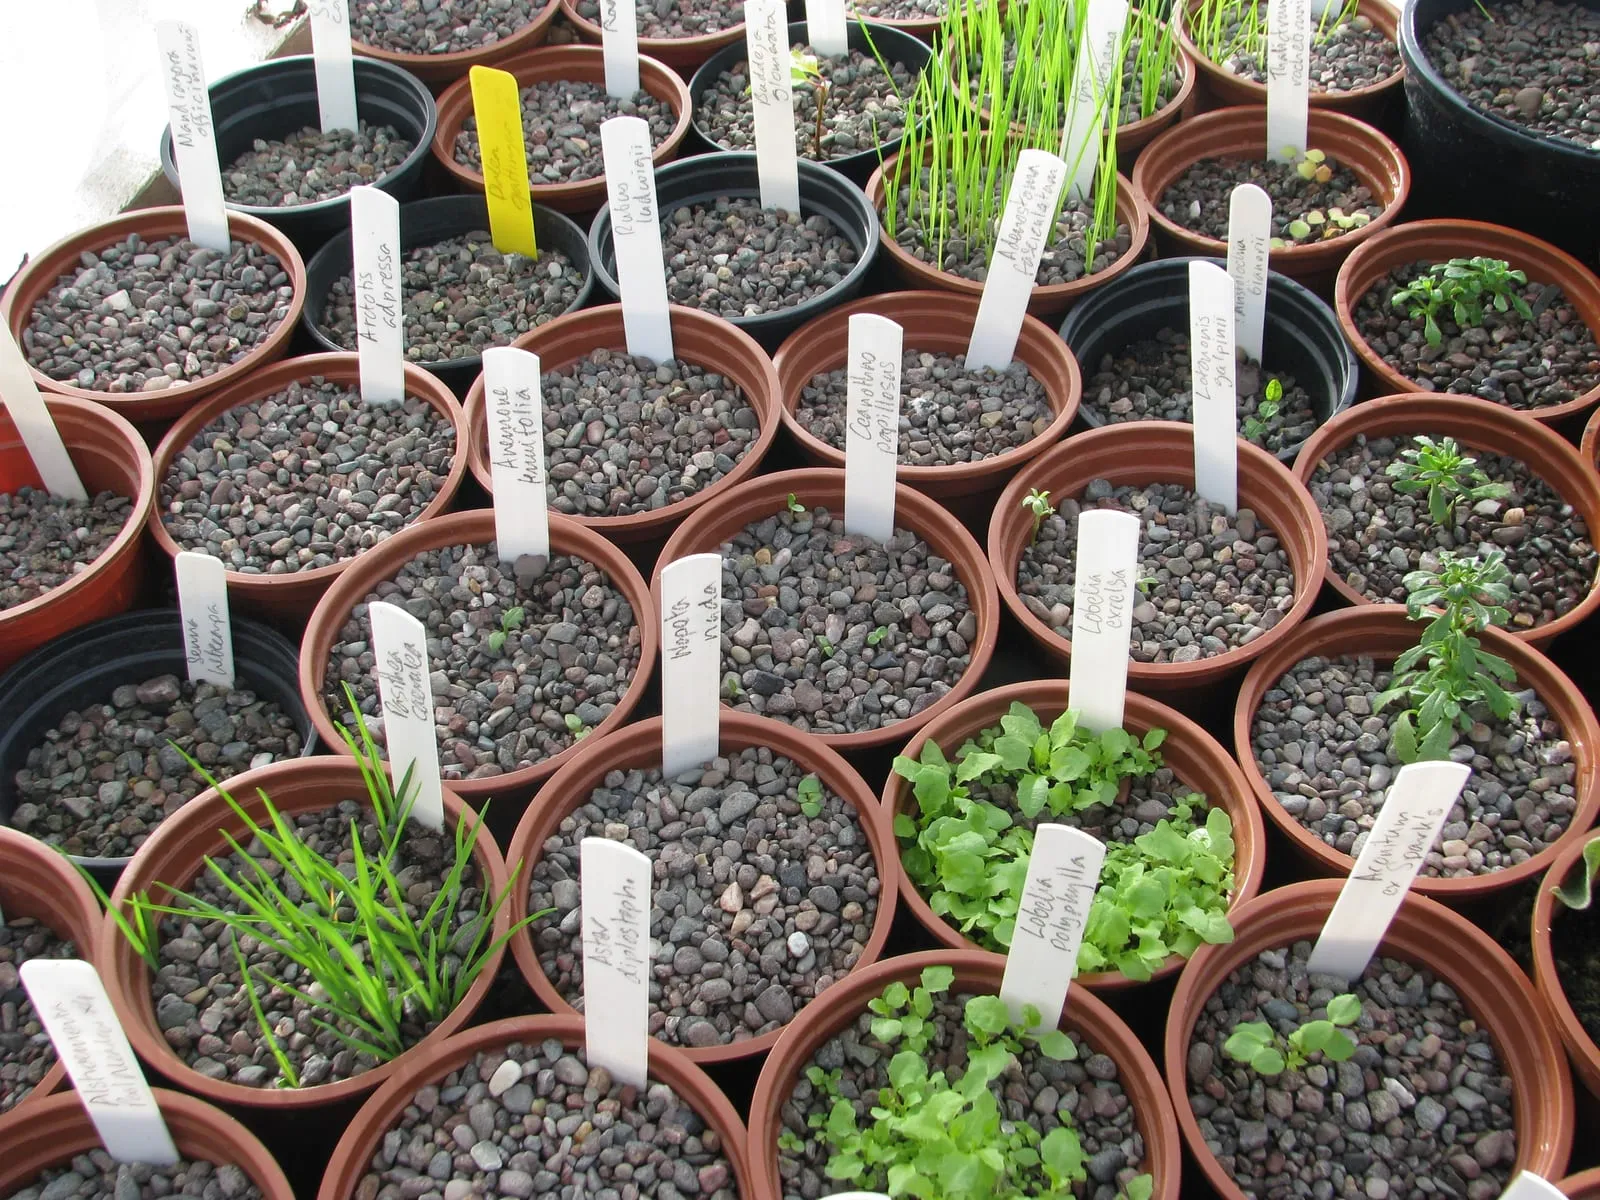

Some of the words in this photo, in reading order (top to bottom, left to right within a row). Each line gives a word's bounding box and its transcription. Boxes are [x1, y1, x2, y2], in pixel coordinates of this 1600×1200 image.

[614, 183, 635, 236] Rubus
[630, 144, 652, 223] ludwigii
[358, 271, 378, 343] Arctotis
[376, 243, 397, 328] adpressa
[1212, 316, 1233, 387] galpinii
[492, 386, 519, 469] Anemone
[874, 360, 897, 454] papillosus
[698, 581, 718, 641] nuda
[1077, 574, 1104, 634] Lobelia
[1104, 568, 1127, 628] excelsa
[187, 618, 204, 664] Senna
[1352, 811, 1409, 882] Aconitum
[1020, 877, 1055, 939] Lobelia
[585, 917, 613, 966] Aster
